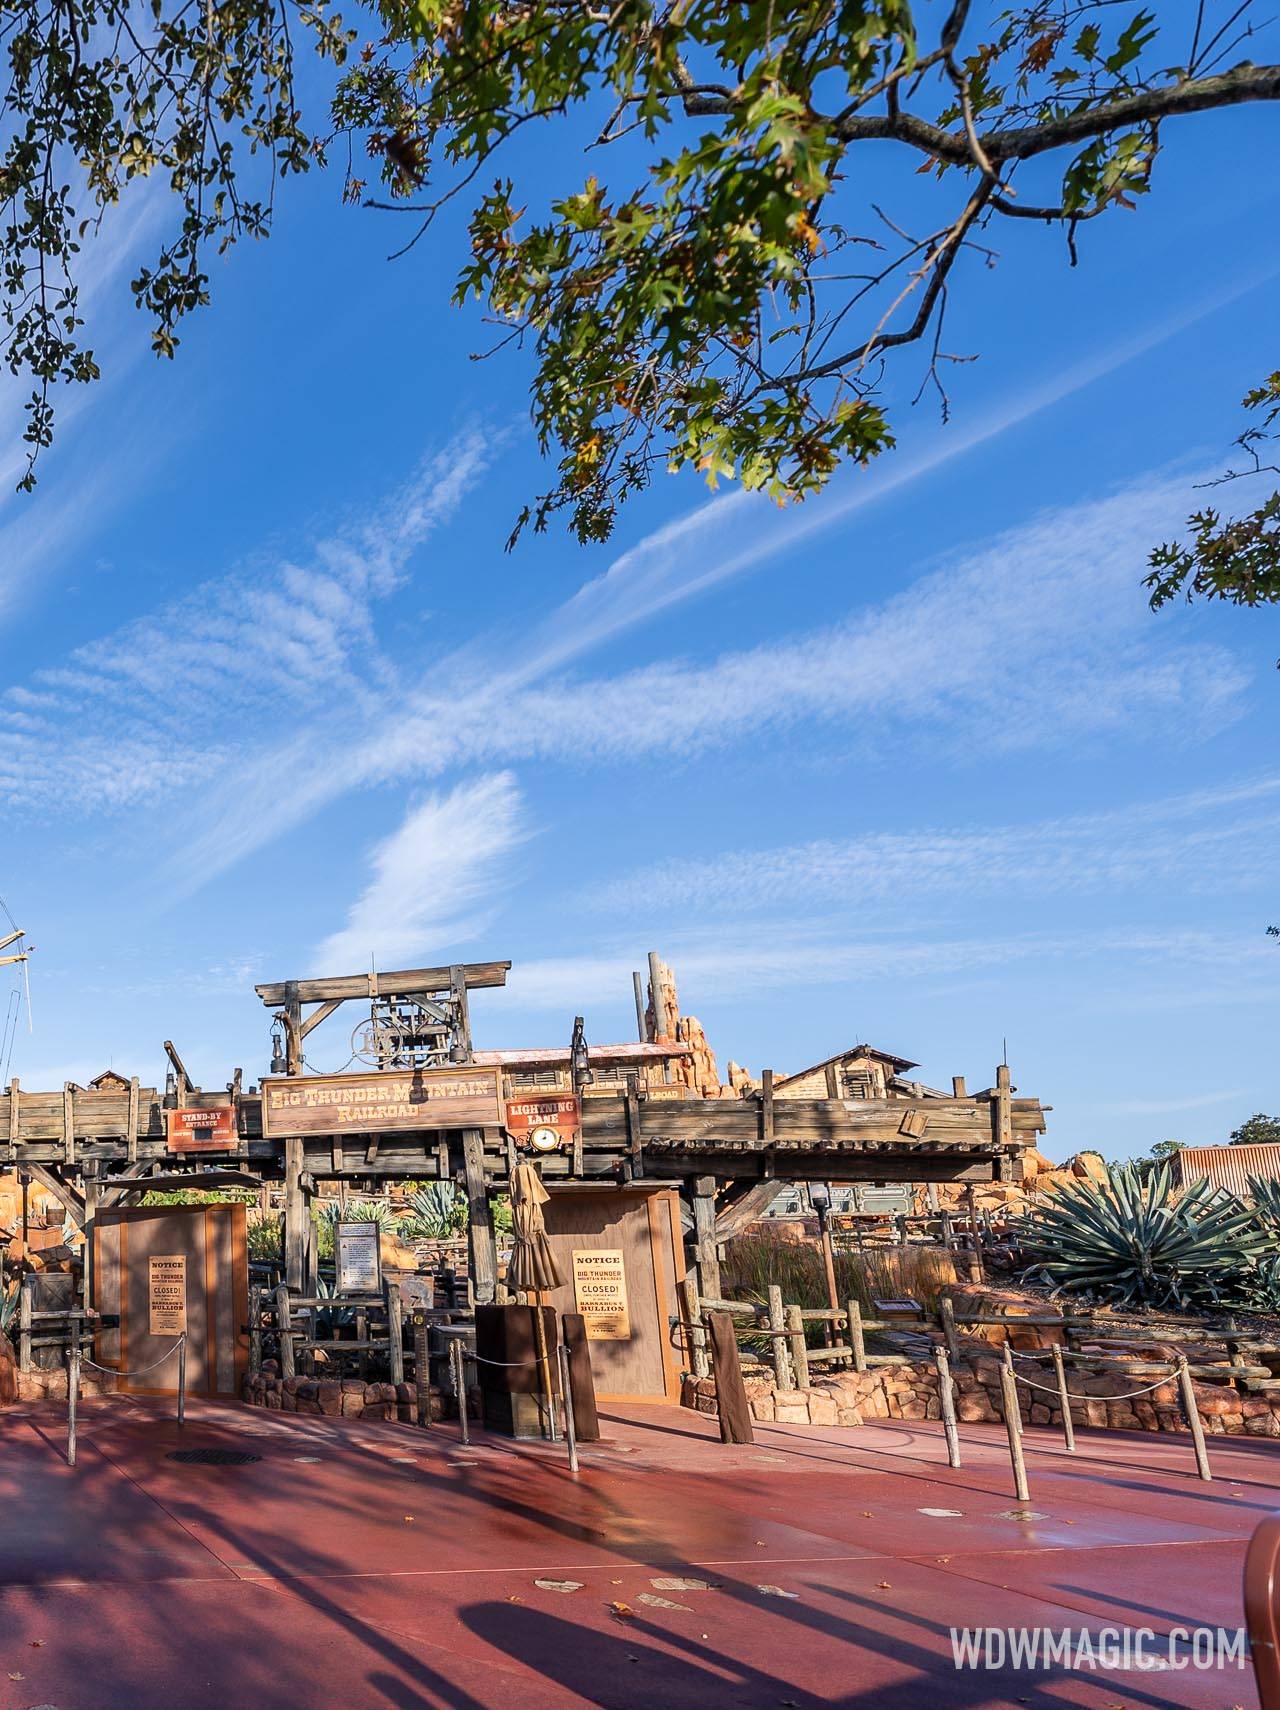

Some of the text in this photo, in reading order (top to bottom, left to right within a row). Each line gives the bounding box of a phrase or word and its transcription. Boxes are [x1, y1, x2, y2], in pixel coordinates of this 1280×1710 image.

[271, 1091, 300, 1108] BIG
[305, 1087, 391, 1107] THUNDER
[337, 1104, 419, 1122] RAILROAD
[510, 1101, 574, 1115] LIGHTNING
[181, 1112, 221, 1122] STAND-BY
[527, 1113, 559, 1125] LANE
